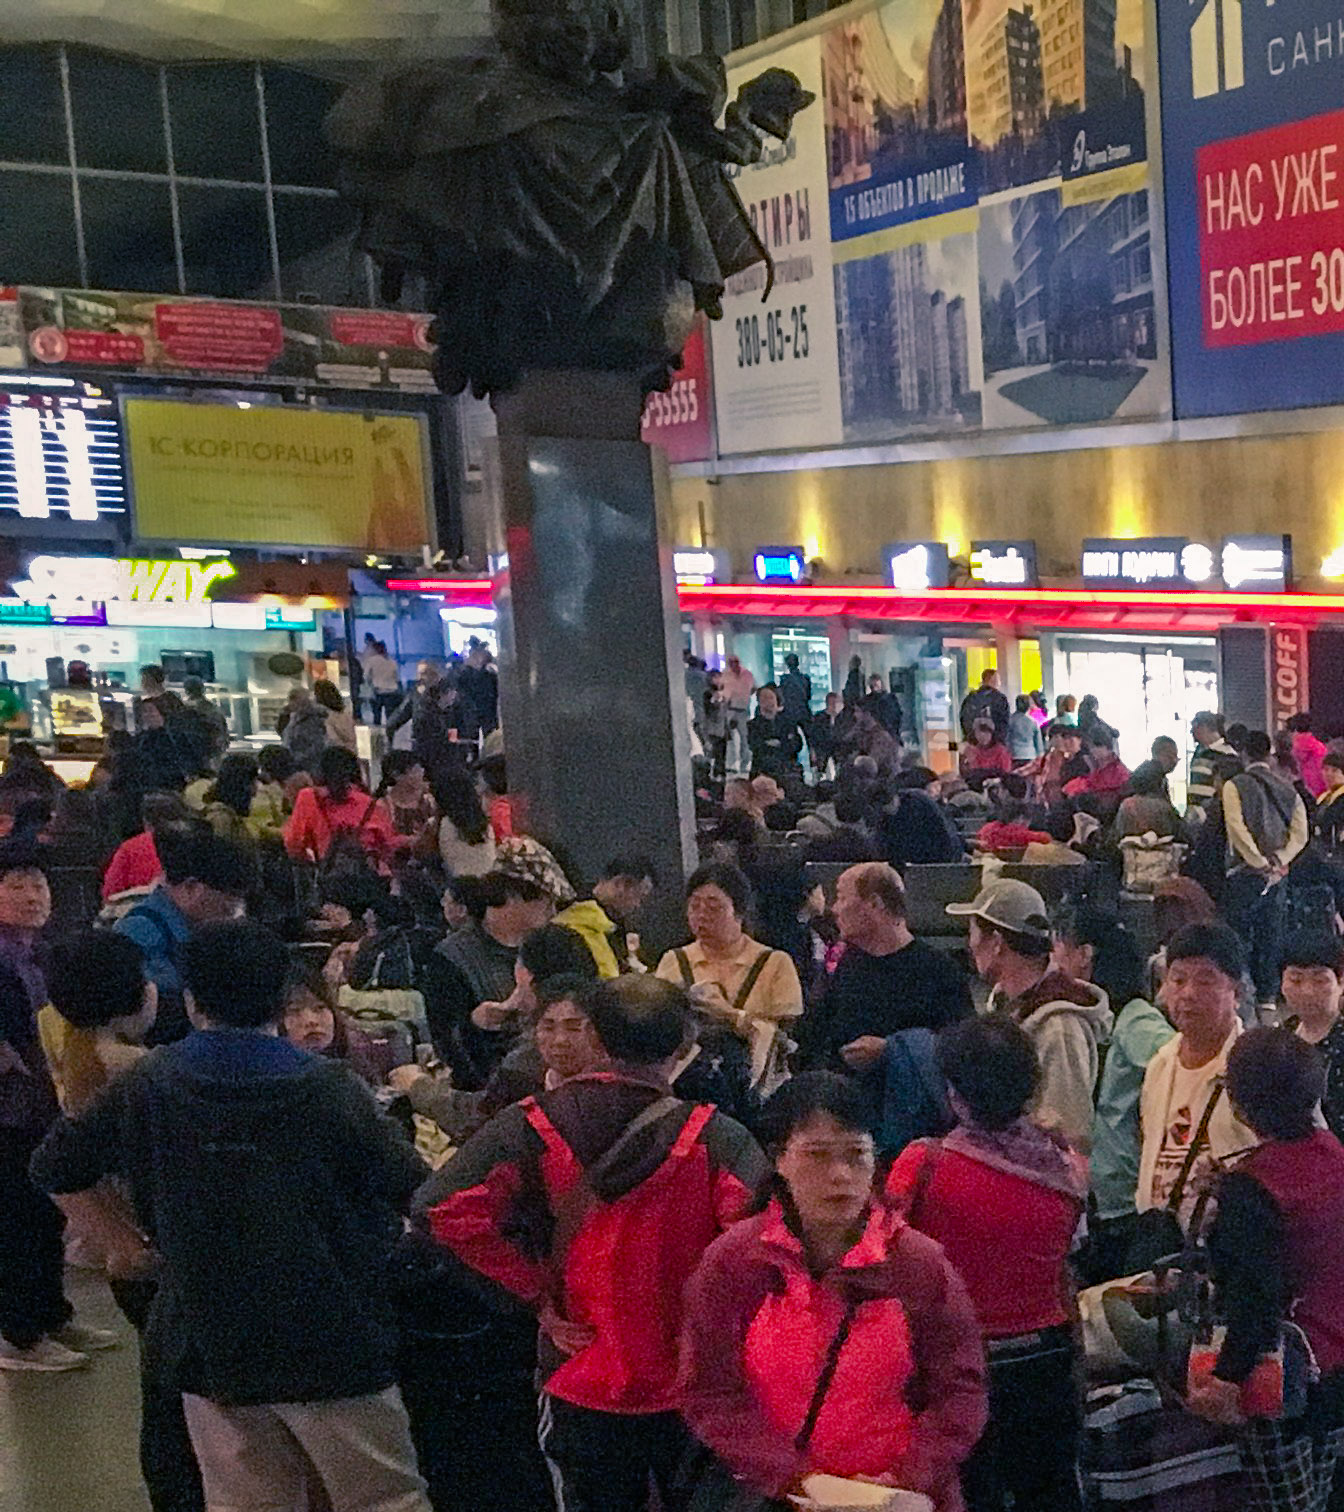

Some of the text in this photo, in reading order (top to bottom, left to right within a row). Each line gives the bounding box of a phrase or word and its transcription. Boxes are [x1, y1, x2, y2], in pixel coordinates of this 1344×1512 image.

[1205, 171, 1264, 235] НАС
[1271, 145, 1340, 223] УЖЕ
[1209, 255, 1304, 330] БОЛЕЕ
[735, 304, 810, 368] 380-05-25
[12, 555, 237, 604] SWAY
